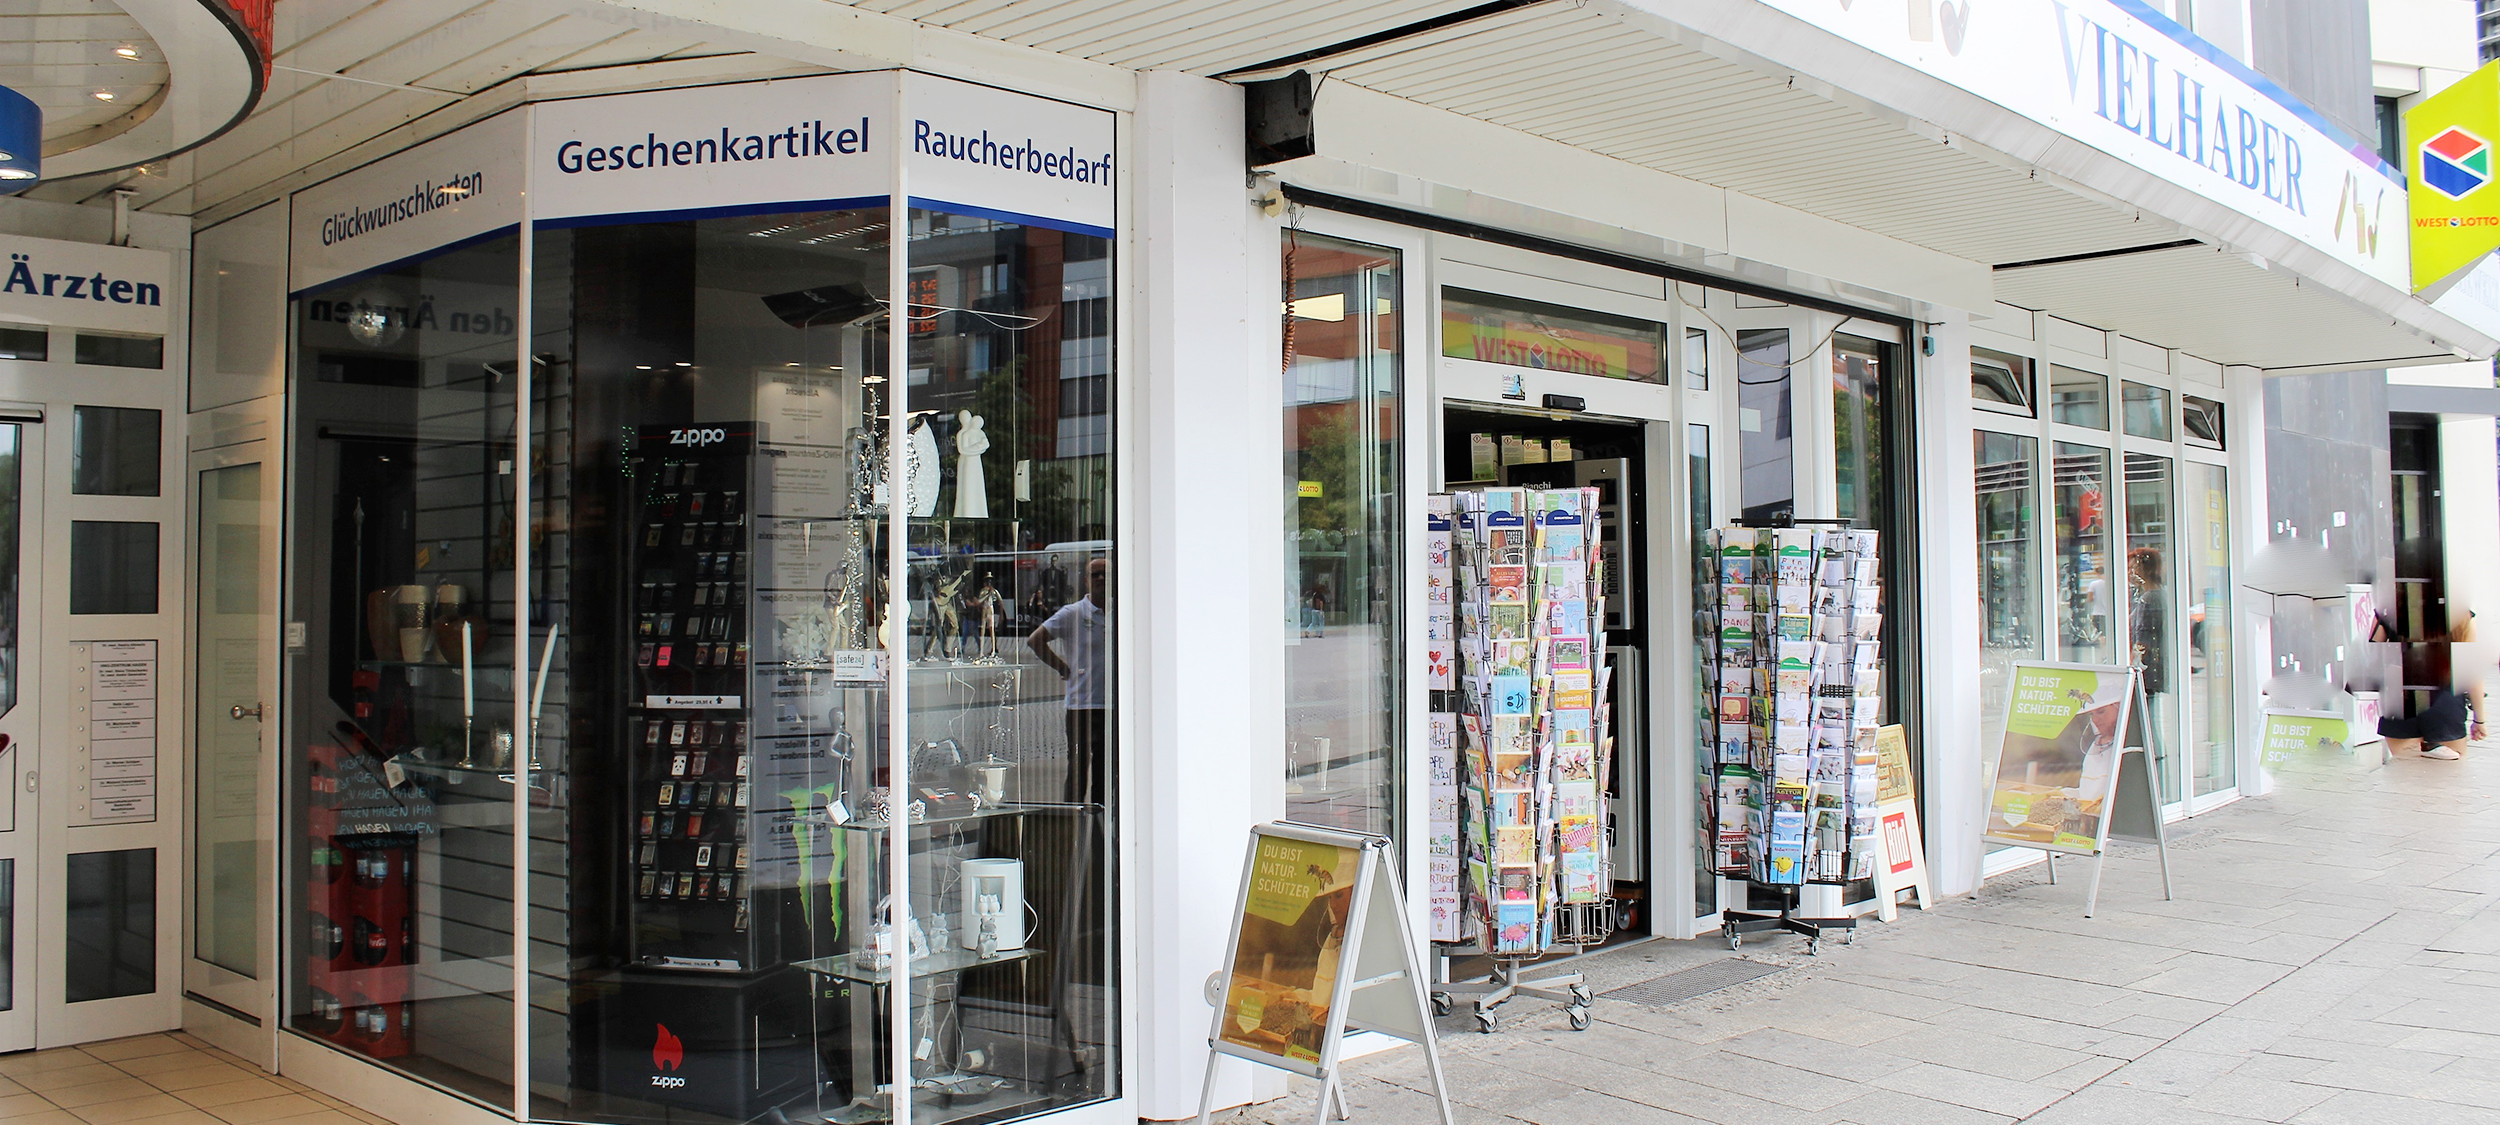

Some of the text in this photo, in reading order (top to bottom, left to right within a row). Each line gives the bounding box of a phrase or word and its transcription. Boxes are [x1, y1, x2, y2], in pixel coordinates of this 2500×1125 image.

[2052, 0, 2307, 217] VIELHABER
[556, 116, 870, 175] Geschenkartikel
[914, 119, 1112, 187] Raucherbedarf
[322, 168, 484, 247] Glückwunschkarten
[2415, 216, 2499, 228] WEST LOTTO
[3, 253, 161, 306] Ärzten
[1472, 334, 1607, 377] WEST LOTTO
[2022, 676, 2061, 688] DU BIST
[2019, 690, 2057, 702] NATUR-
[2016, 702, 2071, 717] SCHÜTZER
[2272, 724, 2312, 736] DU BIST
[2270, 737, 2308, 749] NATUR-
[355, 823, 390, 834] HAGEN
[1884, 818, 1911, 866] Bild
[1264, 844, 1303, 862] DU BIST
[1260, 861, 1297, 879] NATUR-
[1257, 878, 1310, 899] SCHÜTZER
